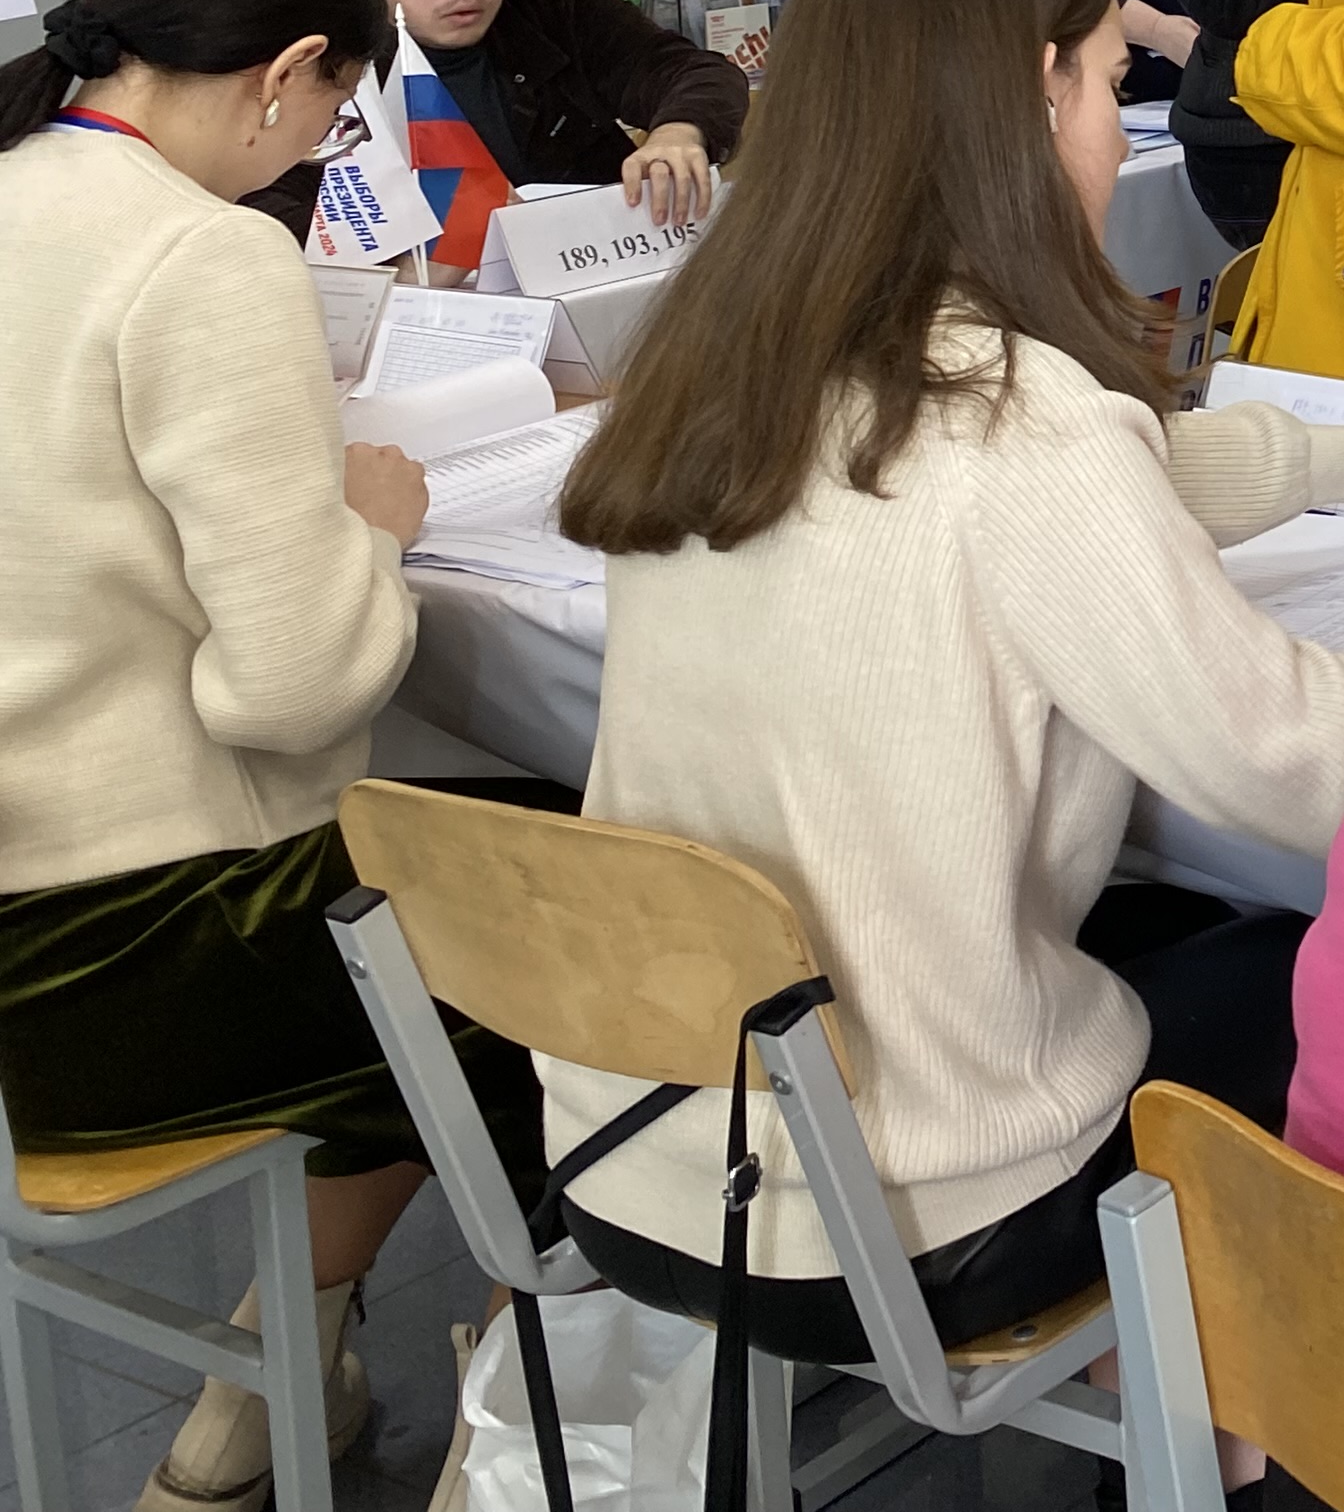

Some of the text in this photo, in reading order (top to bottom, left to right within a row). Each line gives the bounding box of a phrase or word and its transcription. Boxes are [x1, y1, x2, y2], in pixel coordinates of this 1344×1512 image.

[328, 168, 379, 252] ПРЕЗИДЕНТА
[344, 166, 388, 224] ВЫБОРЫ
[319, 233, 338, 256] 2024
[558, 244, 609, 272] 189,
[611, 233, 660, 260] 193,
